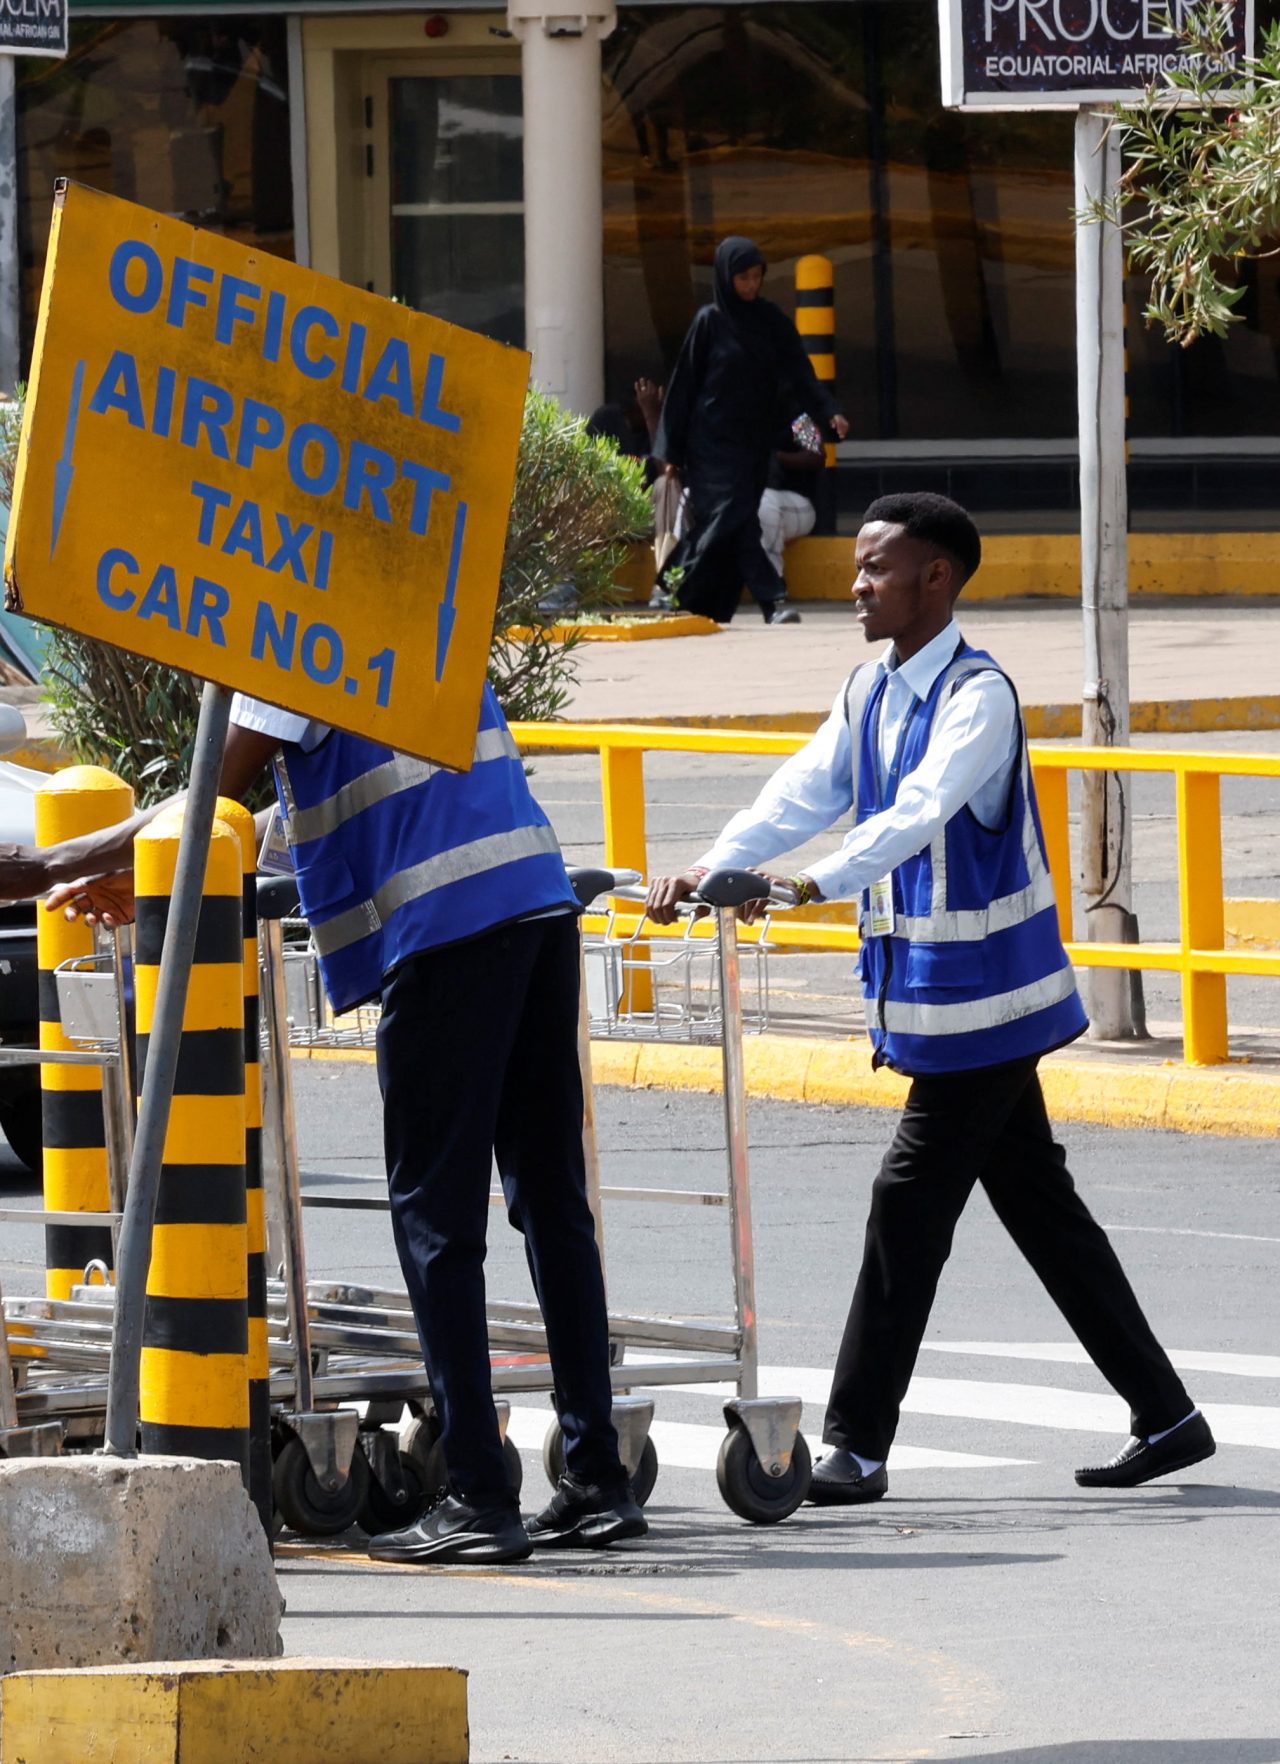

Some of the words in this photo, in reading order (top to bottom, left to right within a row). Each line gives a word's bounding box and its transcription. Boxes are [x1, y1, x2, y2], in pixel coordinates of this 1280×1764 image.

[14, 24, 47, 38] AFRICAN
[47, 25, 60, 38] GIN
[985, 54, 1116, 76] EQUATORIAL
[1121, 53, 1201, 75] AFRICAN
[109, 240, 462, 433] OFFICIAL
[89, 350, 452, 536] AIRPORT
[191, 480, 334, 591] TAXI
[95, 547, 231, 647] CAR
[250, 601, 397, 708] NO.1
